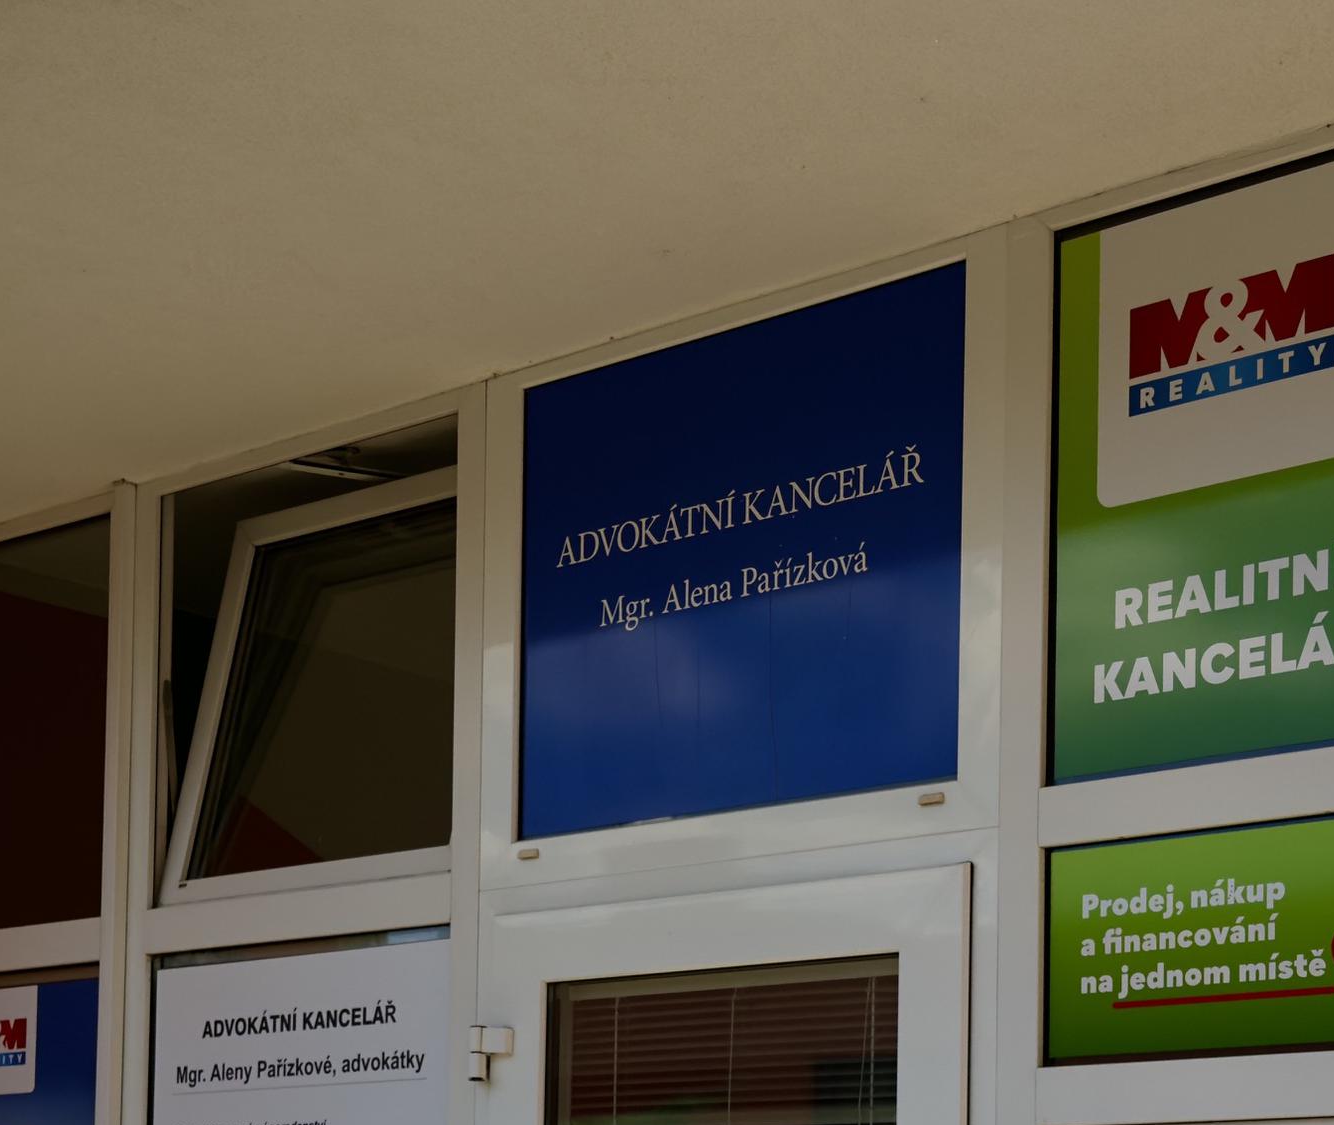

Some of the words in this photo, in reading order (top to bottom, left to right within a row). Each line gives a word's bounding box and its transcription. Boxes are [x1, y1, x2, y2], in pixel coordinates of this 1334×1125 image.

[1134, 339, 1331, 413] REALITY
[556, 489, 736, 568] ADVOKÁTNÍ
[742, 444, 924, 525] KANCELÁŘ
[599, 595, 654, 632] Mgr.
[661, 579, 733, 614] Alena
[740, 541, 868, 598] Pařízková
[1081, 883, 1184, 920] Prodej,
[1190, 877, 1286, 909] nákup
[1080, 938, 1096, 957] a
[1102, 912, 1279, 955] financování
[1080, 974, 1113, 994] na
[1117, 961, 1231, 1000] jednom
[1239, 948, 1327, 983] místě
[202, 1007, 297, 1039] ADVOKÁTNÍ
[302, 999, 396, 1031] KANCELÁŘ
[176, 1065, 206, 1088] Mgr.
[210, 1063, 253, 1085] Aleny
[257, 1055, 336, 1079] Pařízkové,
[341, 1049, 425, 1074] advokátky
